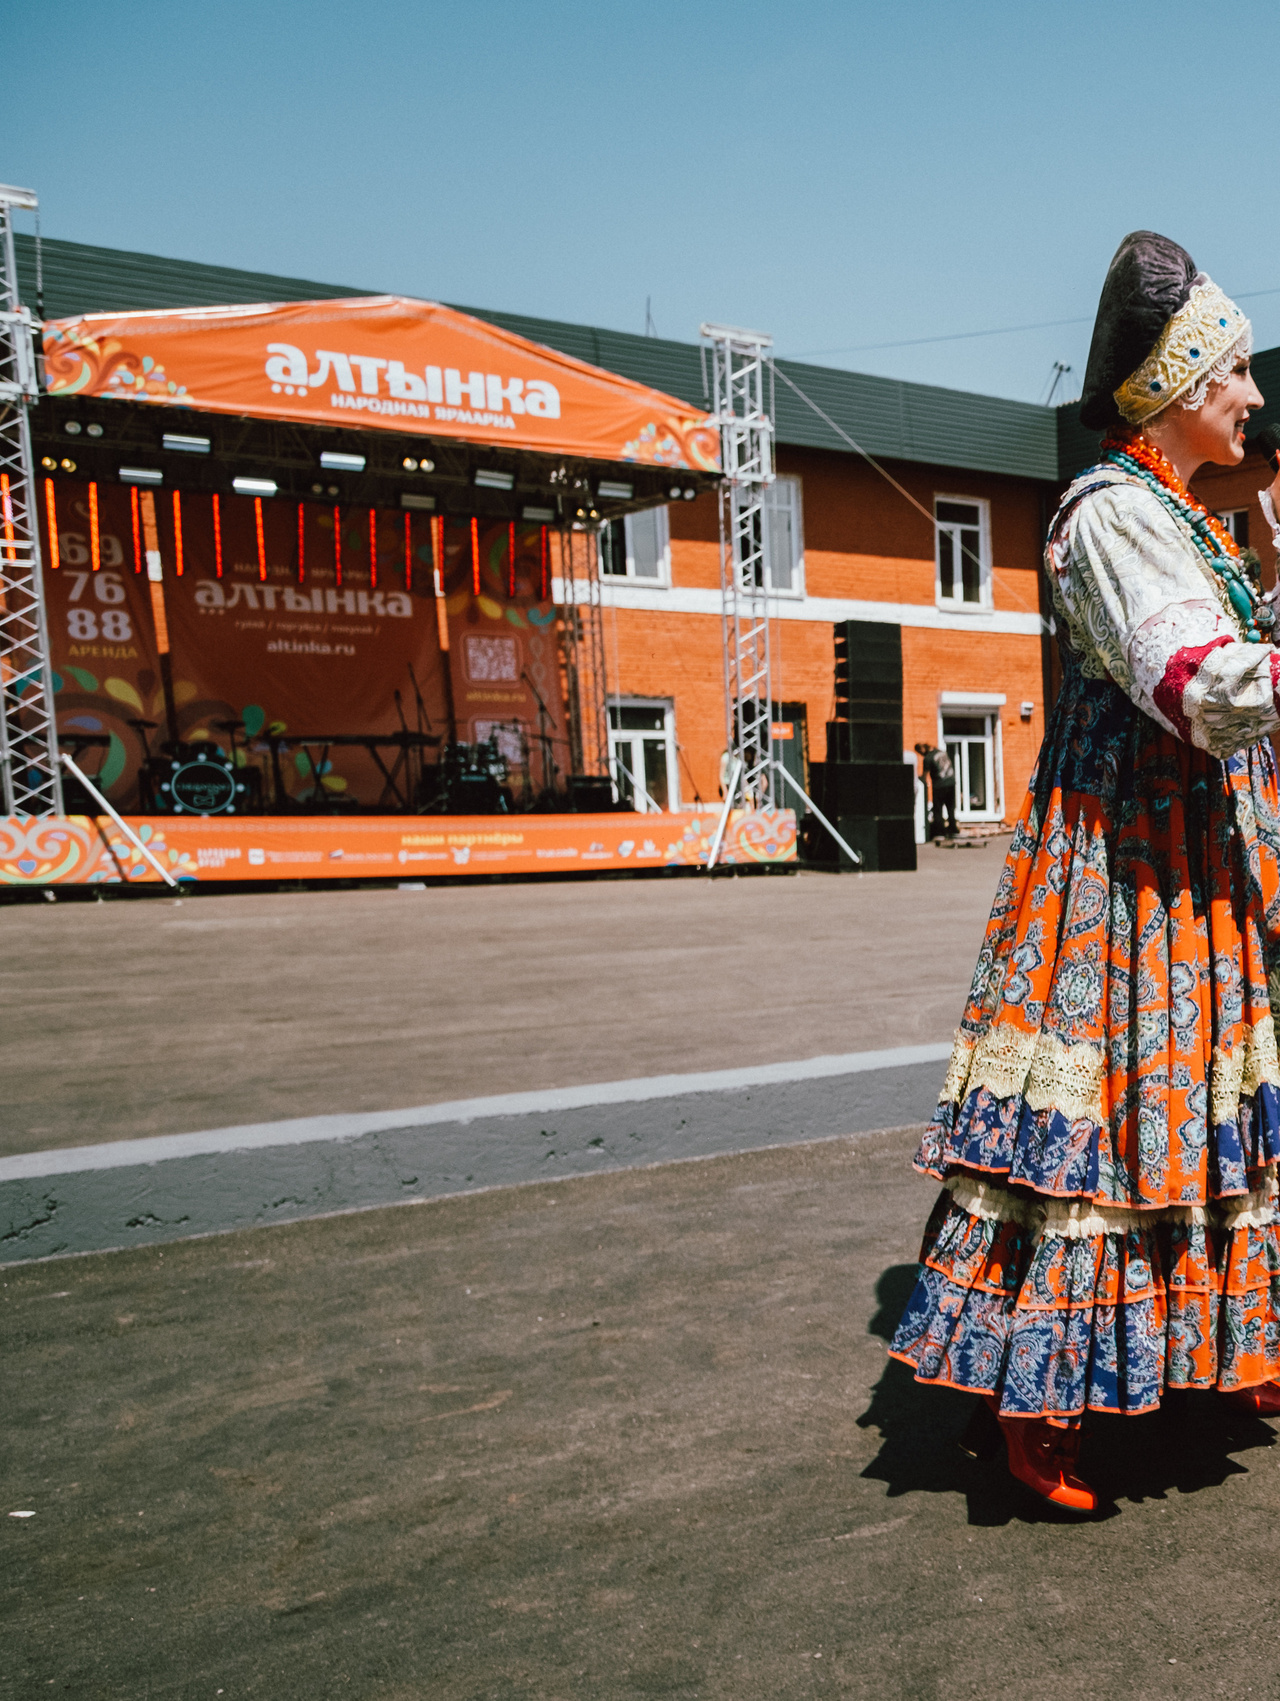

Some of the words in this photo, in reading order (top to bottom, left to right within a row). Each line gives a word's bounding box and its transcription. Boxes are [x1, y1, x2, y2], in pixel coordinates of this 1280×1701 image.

[330, 393, 430, 418] НАРОДНАЯ
[434, 405, 516, 430] ЯРМАРКА
[58, 532, 124, 567] 69
[63, 571, 126, 605] 76
[66, 608, 132, 642] 88
[68, 644, 138, 660] АРЕНДА
[267, 638, 356, 656] altinka.ru
